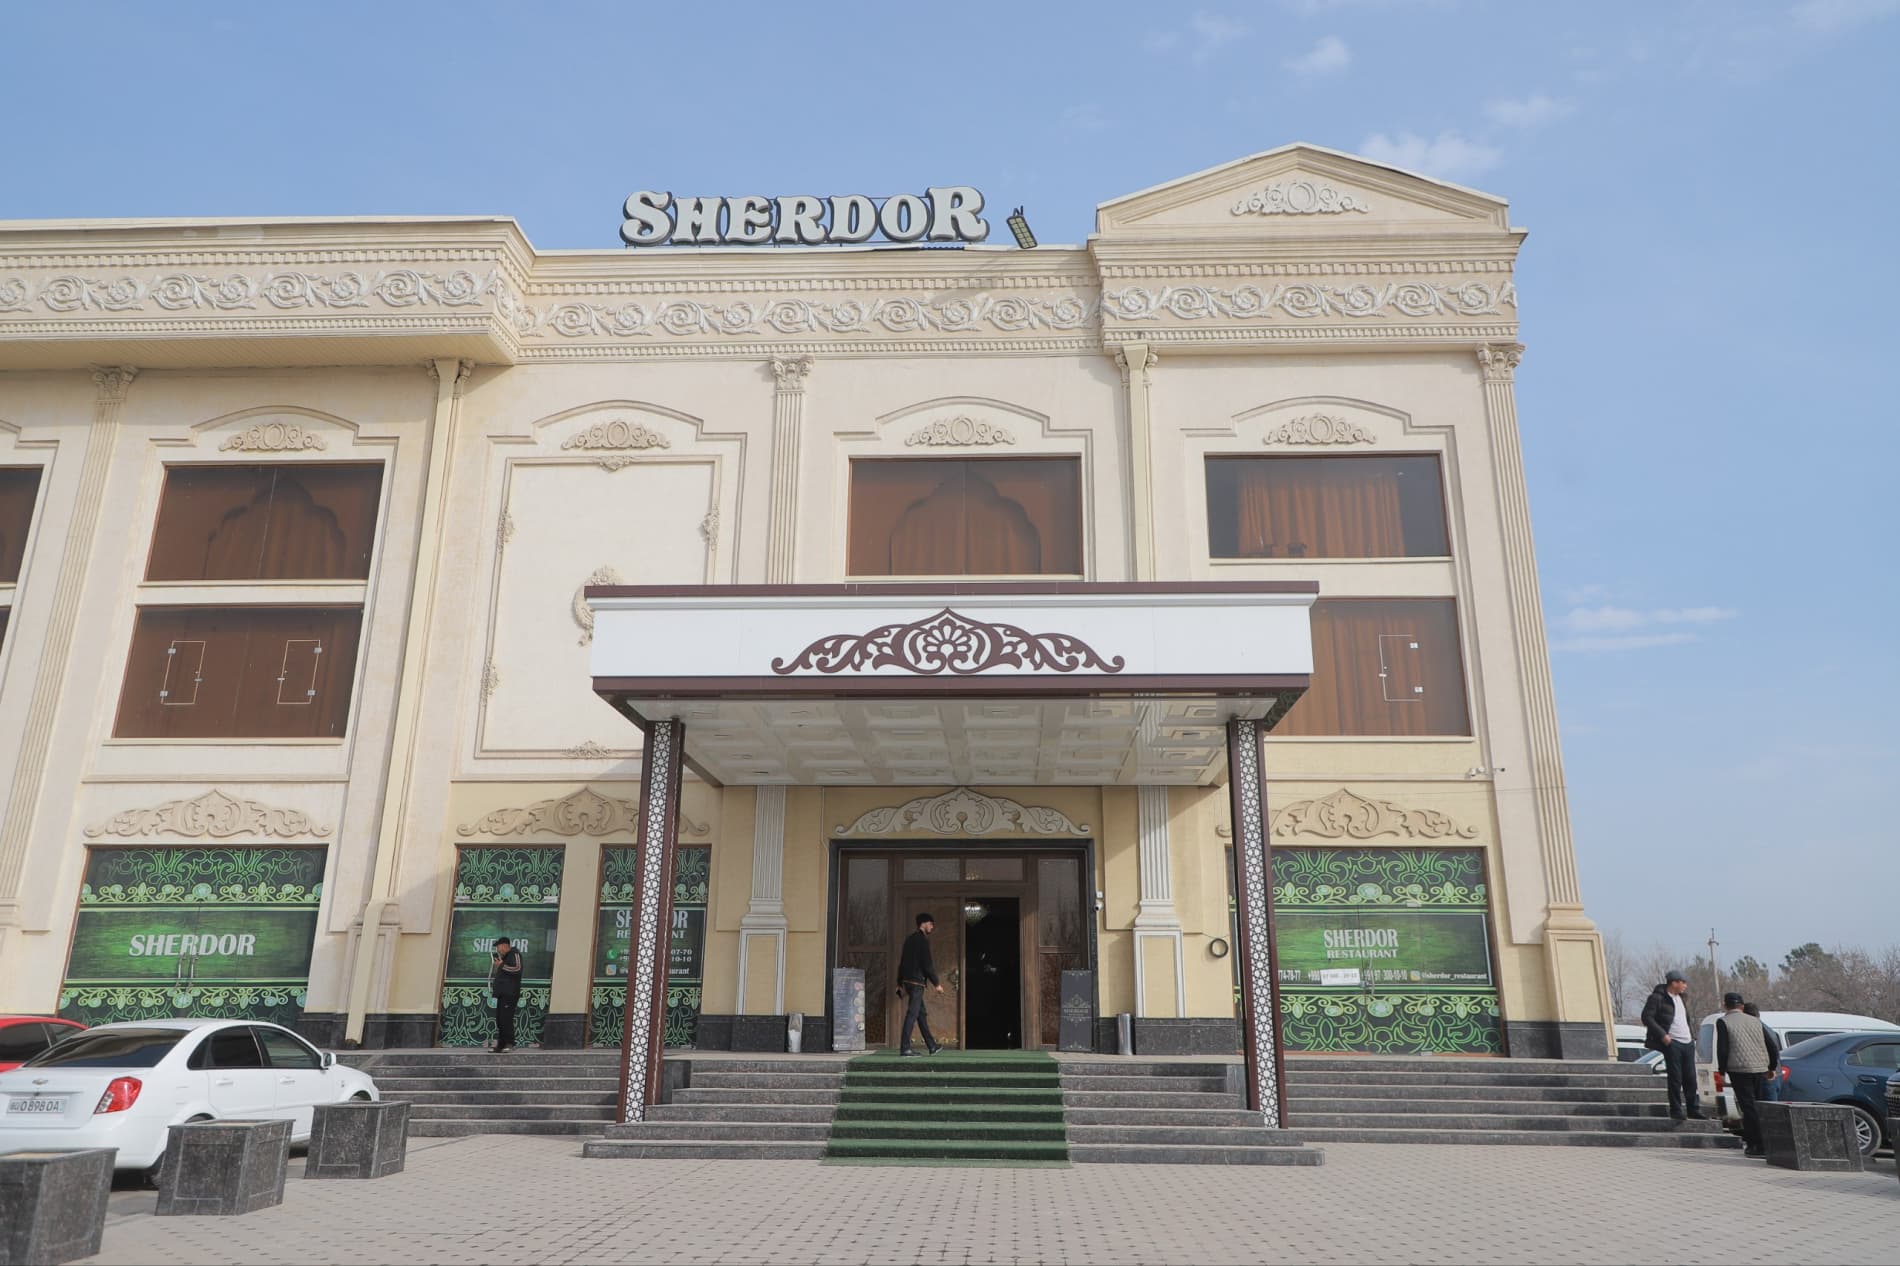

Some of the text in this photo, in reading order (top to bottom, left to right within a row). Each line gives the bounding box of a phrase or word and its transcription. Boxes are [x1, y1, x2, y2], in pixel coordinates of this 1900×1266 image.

[620, 186, 990, 246] SHERDOR
[129, 933, 257, 957] SHERDOR
[472, 938, 529, 953] SHEOR
[1323, 928, 1399, 948] SHERDOR
[1326, 949, 1398, 959] RESTAURANT
